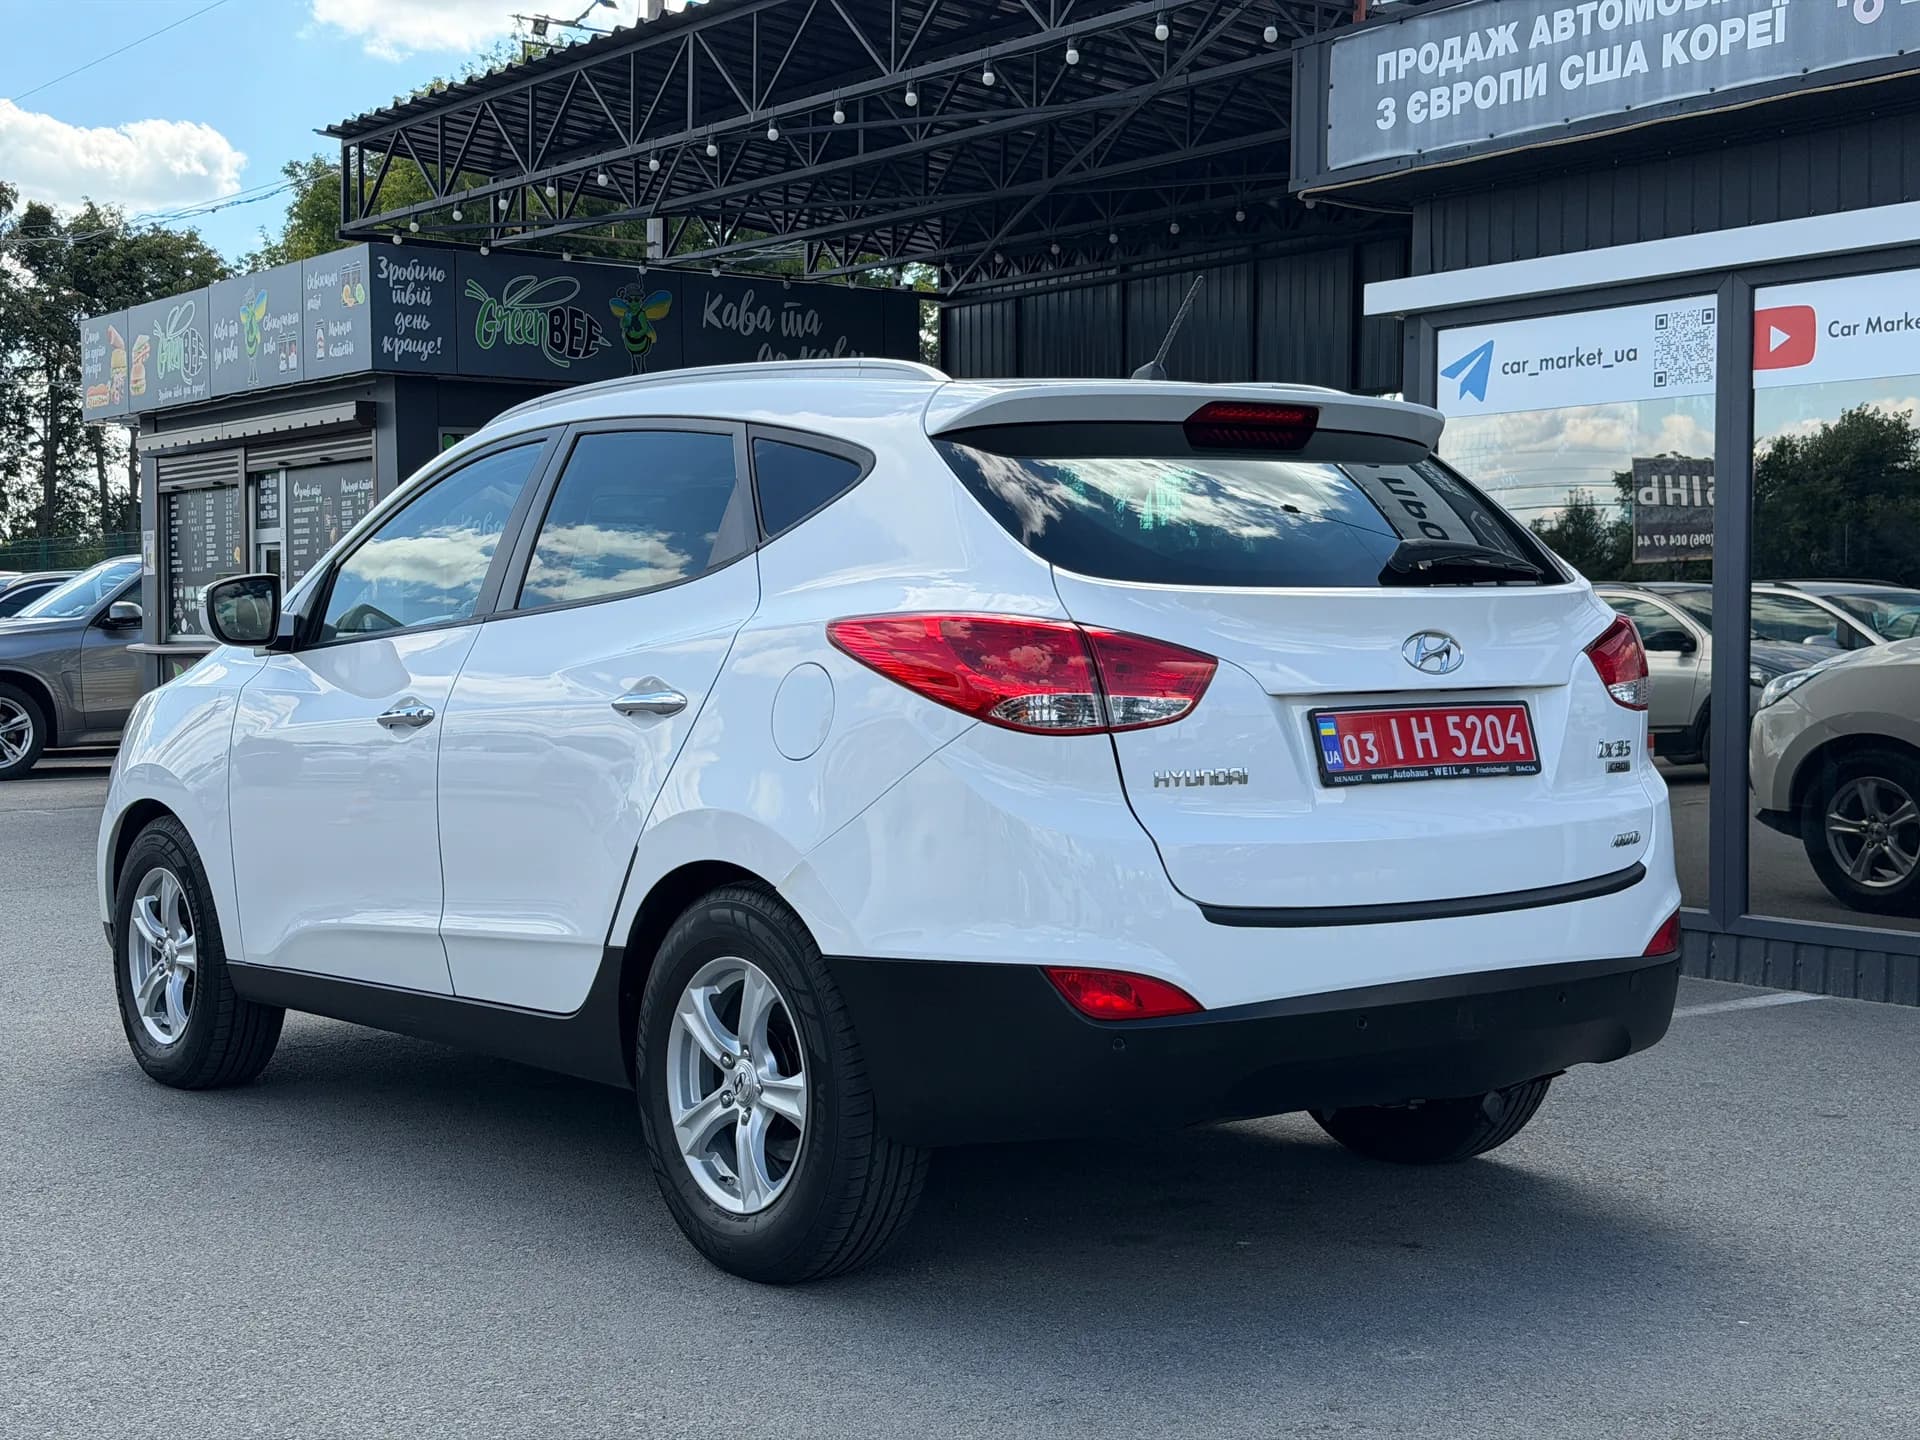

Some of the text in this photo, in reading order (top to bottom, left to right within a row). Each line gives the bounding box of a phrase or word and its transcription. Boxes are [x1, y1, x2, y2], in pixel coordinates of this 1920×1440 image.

[1376, 19, 1519, 85] ПРОДАЖ
[1376, 98, 1396, 131] З
[1406, 66, 1547, 125] ЄВРОПИ
[1560, 40, 1649, 91] США
[1662, 0, 1787, 68] КОРЕЇ
[377, 256, 447, 287] Зробимо
[391, 283, 432, 306] твій
[394, 311, 431, 335] день
[702, 289, 823, 337] Кава та
[1828, 320, 1860, 338] Car
[381, 335, 443, 362] краще!
[1501, 344, 1638, 377] car_market_ua
[1343, 732, 1379, 765] 03
[1446, 714, 1526, 757] 5204
[1325, 751, 1342, 765] UA
[1153, 767, 1249, 788] HYUNDAI
[1334, 775, 1363, 783] RENAULT
